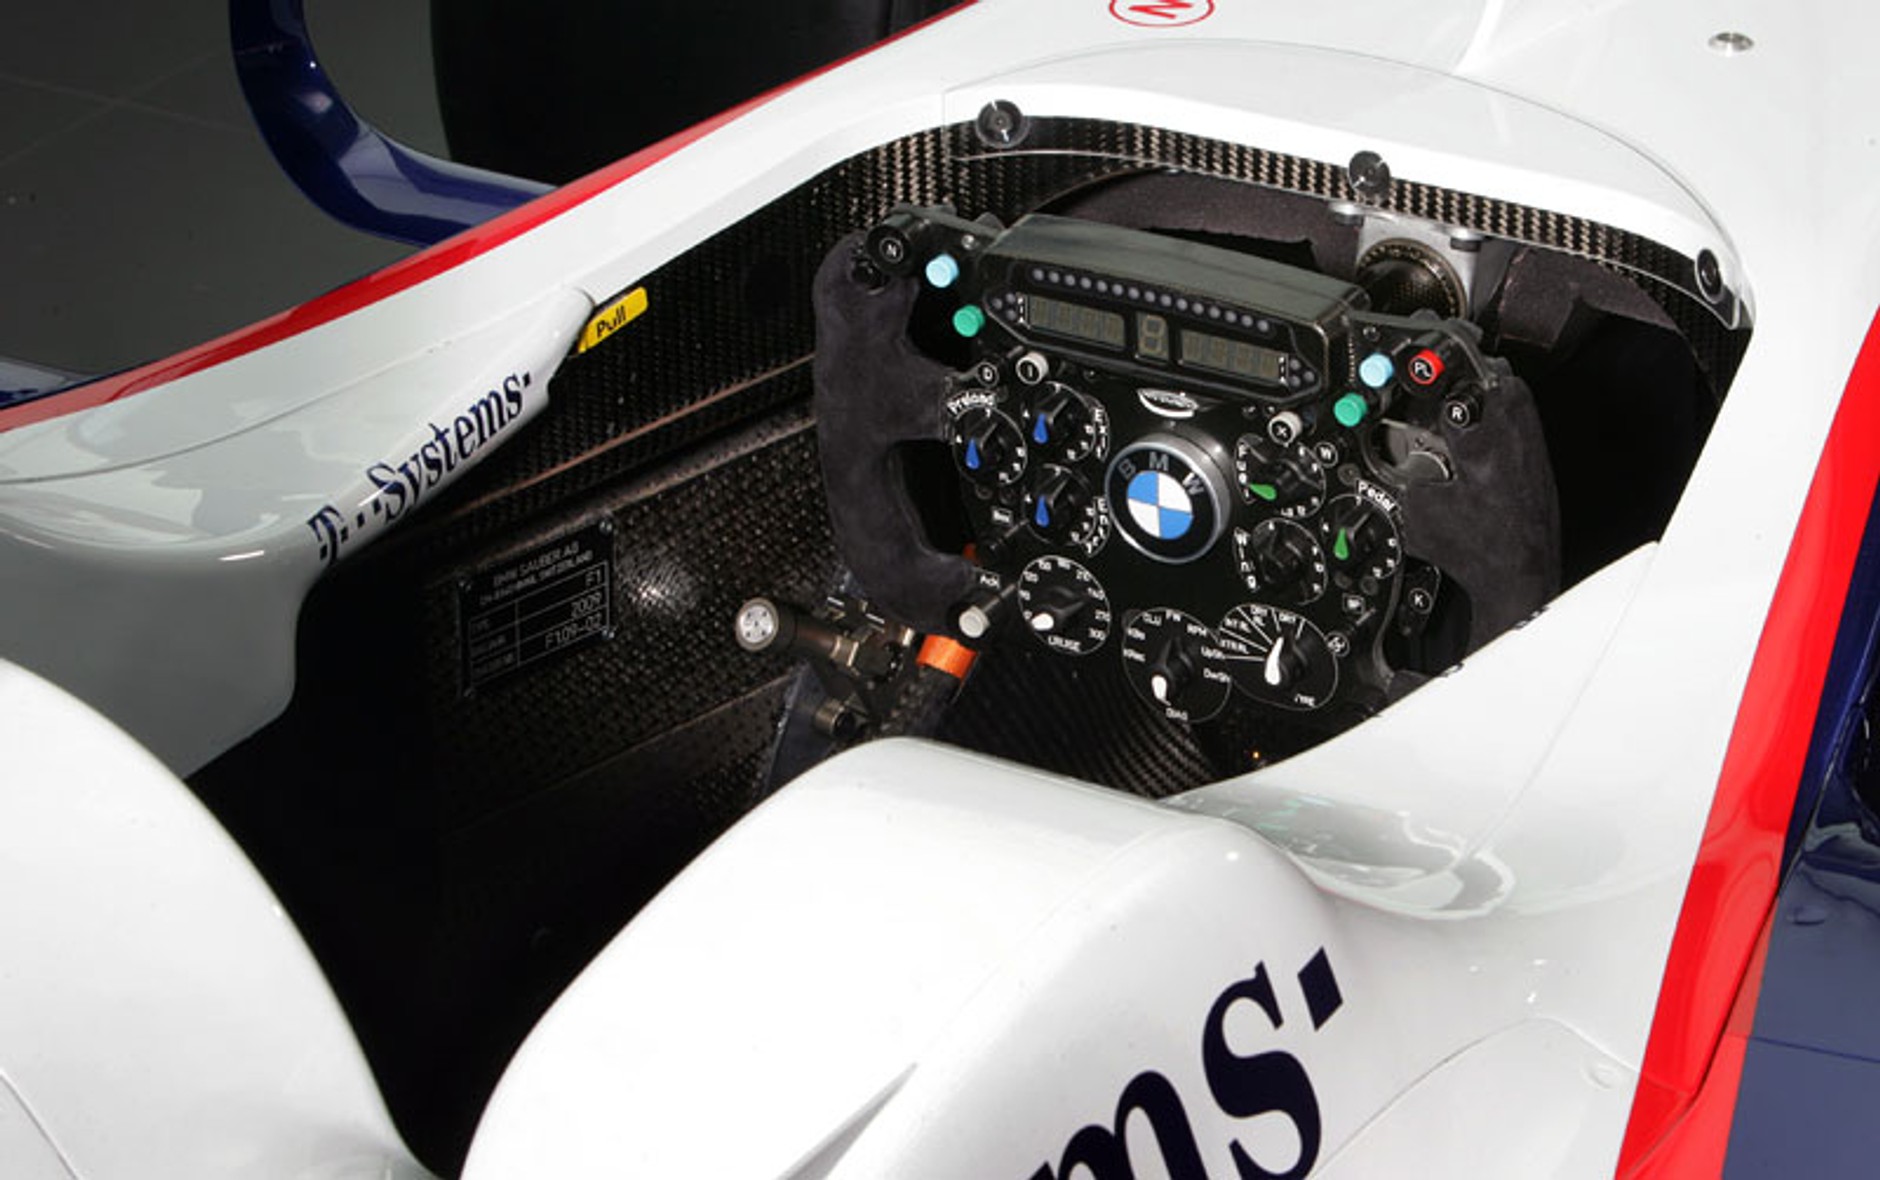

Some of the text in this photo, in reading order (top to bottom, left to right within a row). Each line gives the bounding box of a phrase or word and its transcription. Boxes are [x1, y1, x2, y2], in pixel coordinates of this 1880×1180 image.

[596, 305, 627, 339] Pull
[946, 392, 997, 415] Preload
[1452, 406, 1463, 420] R
[1118, 452, 1206, 499] BMW
[1358, 481, 1396, 512] Pedal
[584, 570, 602, 586] F1
[570, 592, 602, 618] 2009
[1414, 594, 1425, 607] K
[1186, 623, 1208, 636] RPM
